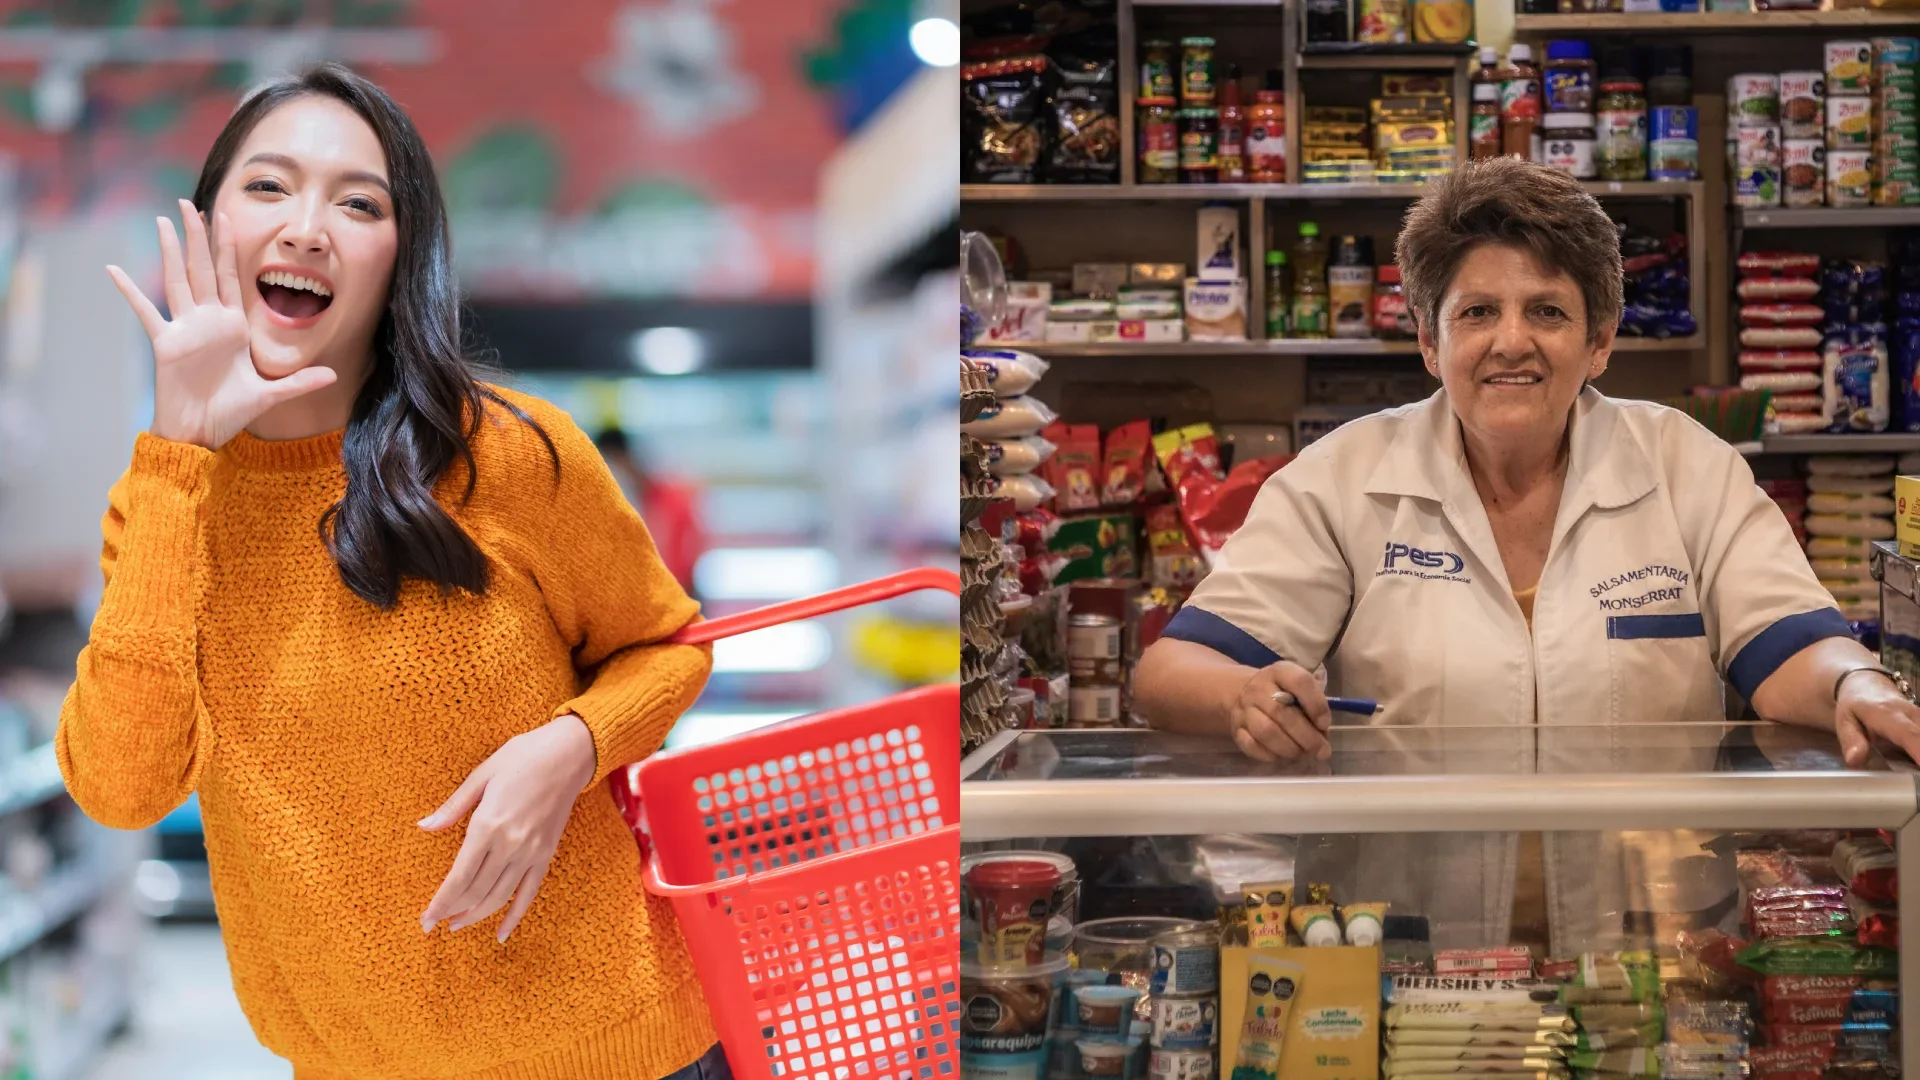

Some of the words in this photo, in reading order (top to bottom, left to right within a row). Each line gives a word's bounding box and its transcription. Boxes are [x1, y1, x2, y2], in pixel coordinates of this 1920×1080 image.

[1451, 575, 1472, 584] Social
[1589, 565, 1689, 598] SALSAMENTARIA
[1599, 587, 1683, 610] MONSERRAT
[1397, 976, 1514, 991] HERSHEY'S
[1321, 1008, 1348, 1018] Leche
